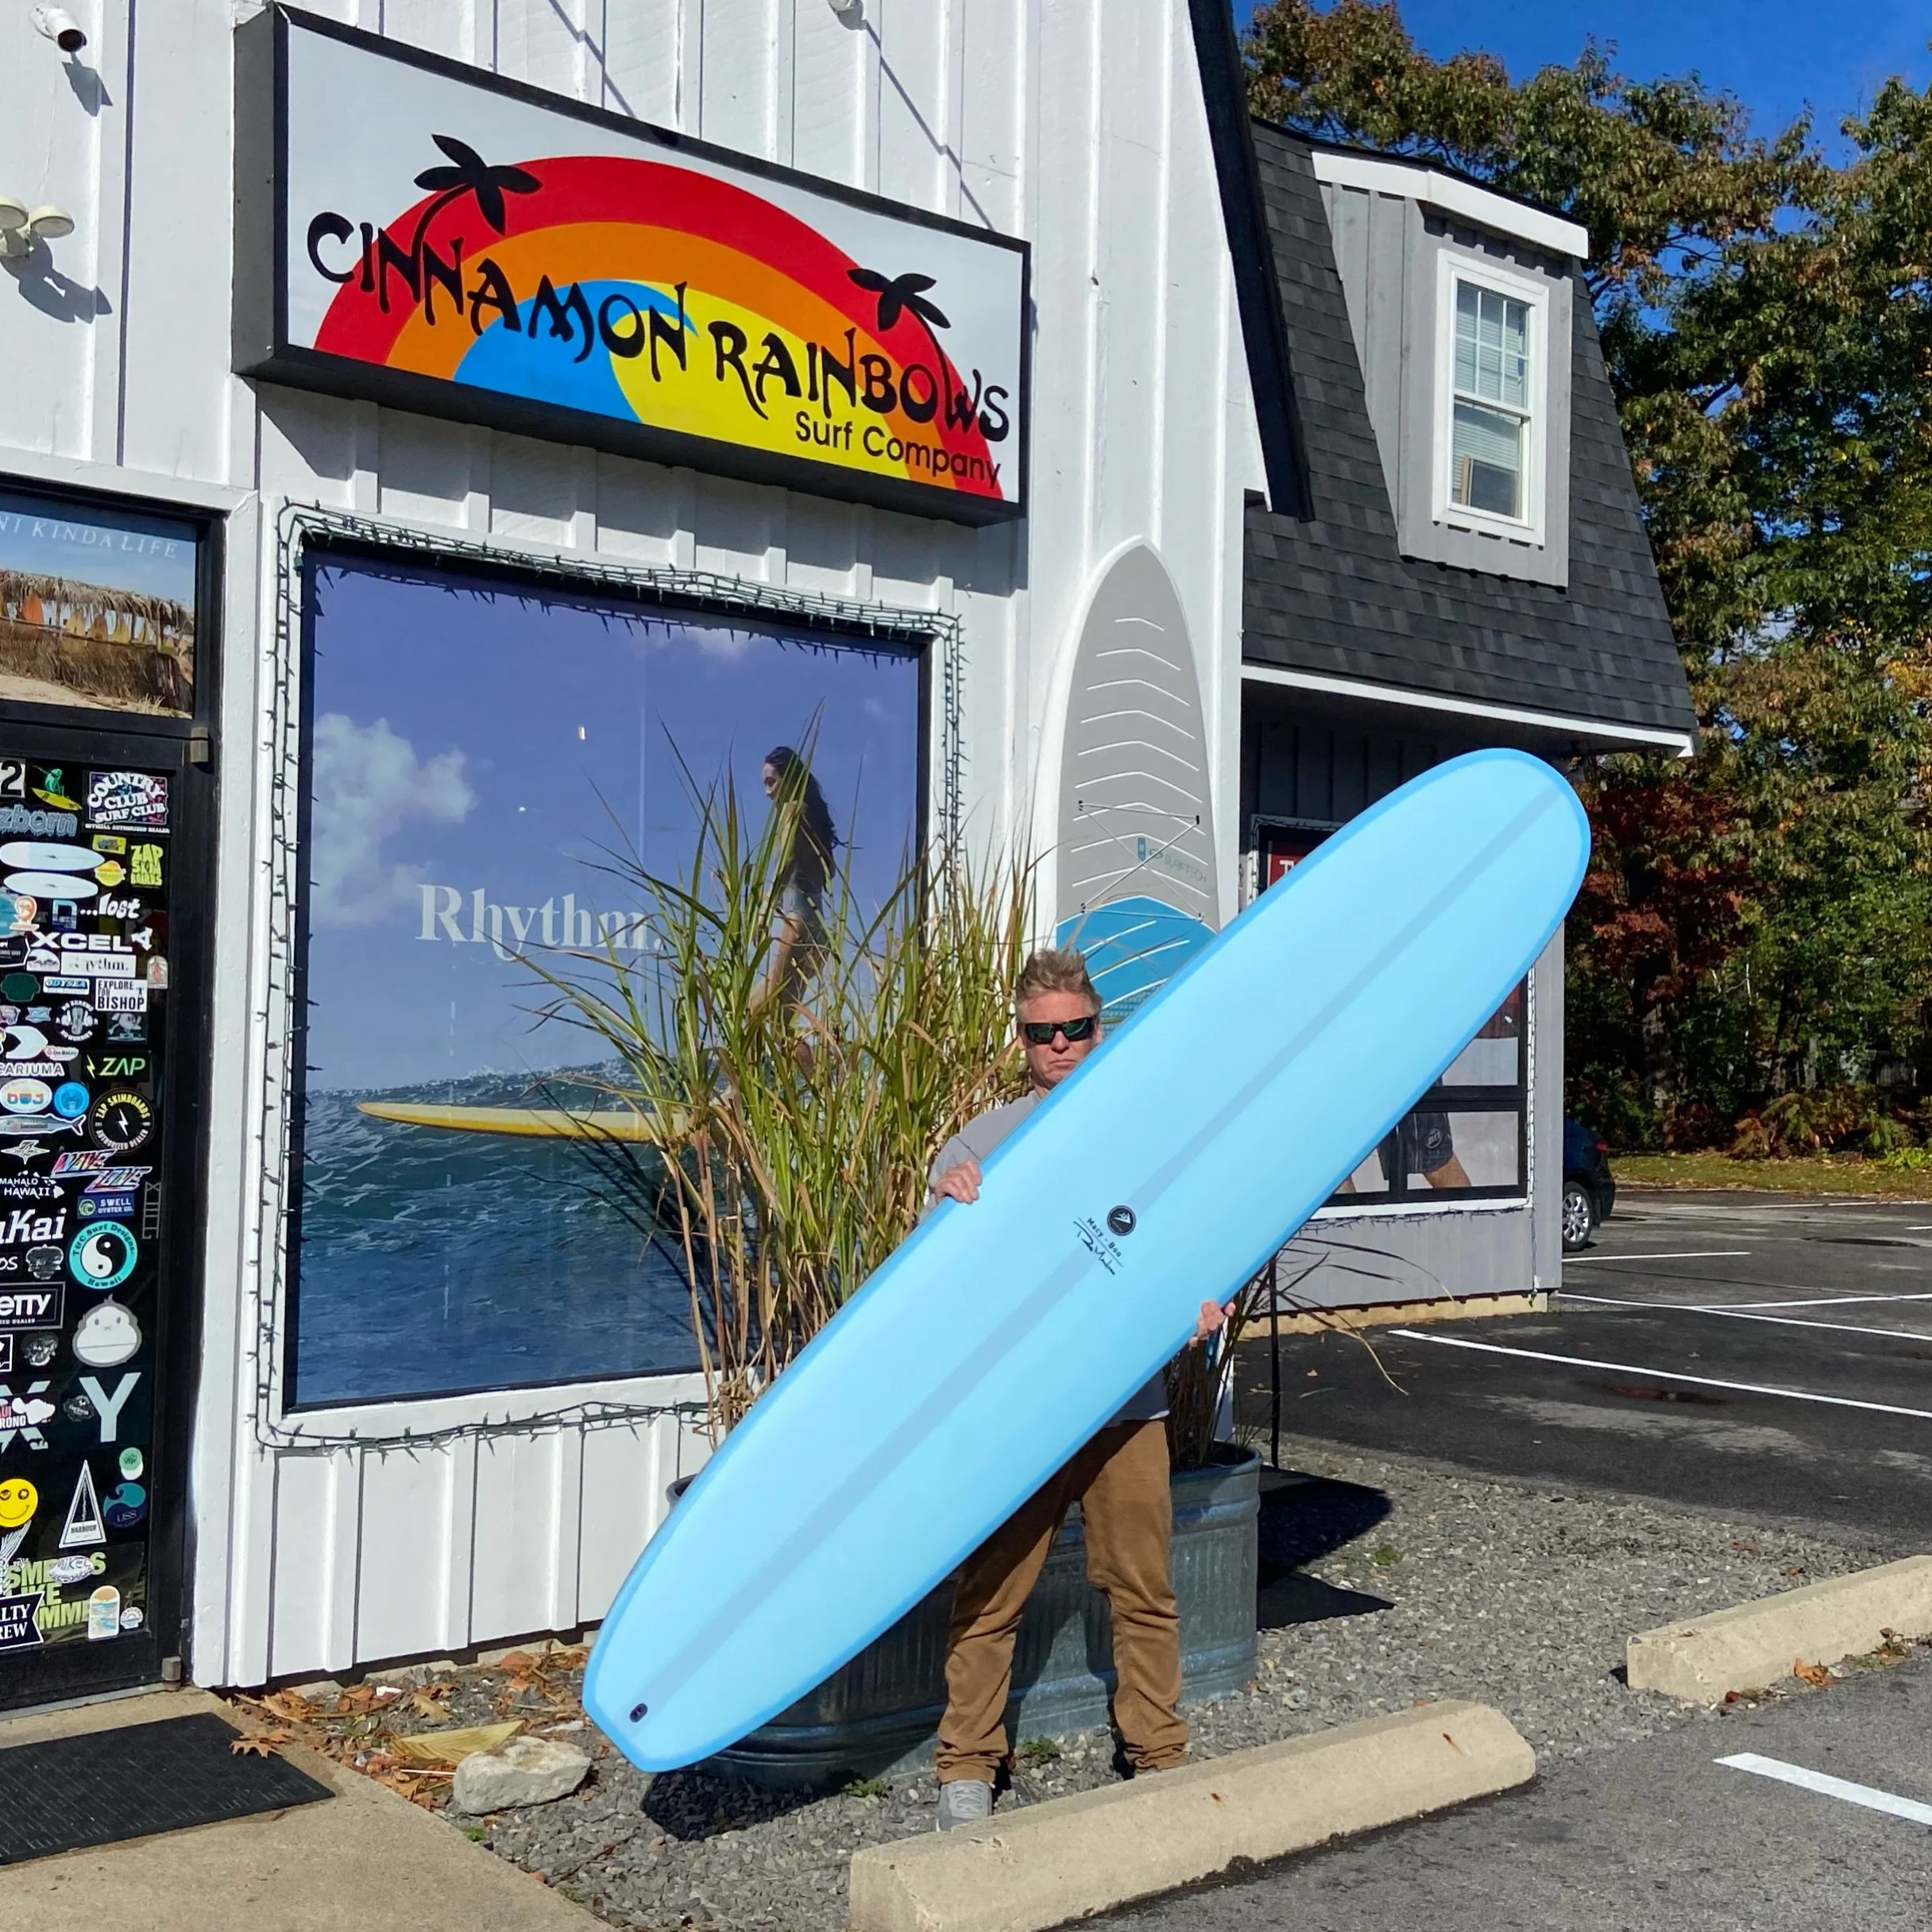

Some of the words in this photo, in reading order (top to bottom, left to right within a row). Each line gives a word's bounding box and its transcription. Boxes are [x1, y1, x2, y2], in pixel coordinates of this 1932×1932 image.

[307, 211, 689, 381] CINNAMON
[707, 321, 1010, 442] RAINBOWS
[795, 411, 853, 450] Surf
[863, 427, 1002, 489] Company
[32, 521, 112, 548] KINDA
[120, 535, 179, 558] LIFE
[1, 760, 22, 796] 2
[87, 772, 166, 808] COUNTRY
[104, 792, 149, 810] CLUB
[95, 809, 129, 823] SURF
[131, 803, 166, 817] CLUB
[130, 844, 164, 866] ZAP
[31, 931, 133, 952] XCEL
[98, 980, 134, 991] EXPLORE
[97, 996, 145, 1010] BISHOP
[99, 1057, 145, 1076] ZAP
[96, 1103, 108, 1119] ZAP
[107, 1093, 151, 1119] SKIMBOARDS
[95, 1130, 129, 1150] AUTHORIZED
[129, 1129, 149, 1148] DEALER
[0, 1177, 39, 1188] MAHALO
[4, 1187, 51, 1200] HAWAII
[100, 1198, 131, 1207] SWELL
[86, 1223, 108, 1236] Surf
[110, 1224, 136, 1252] Designs
[87, 1275, 122, 1287] Hawaii
[71, 1524, 97, 1534] HARBOUR
